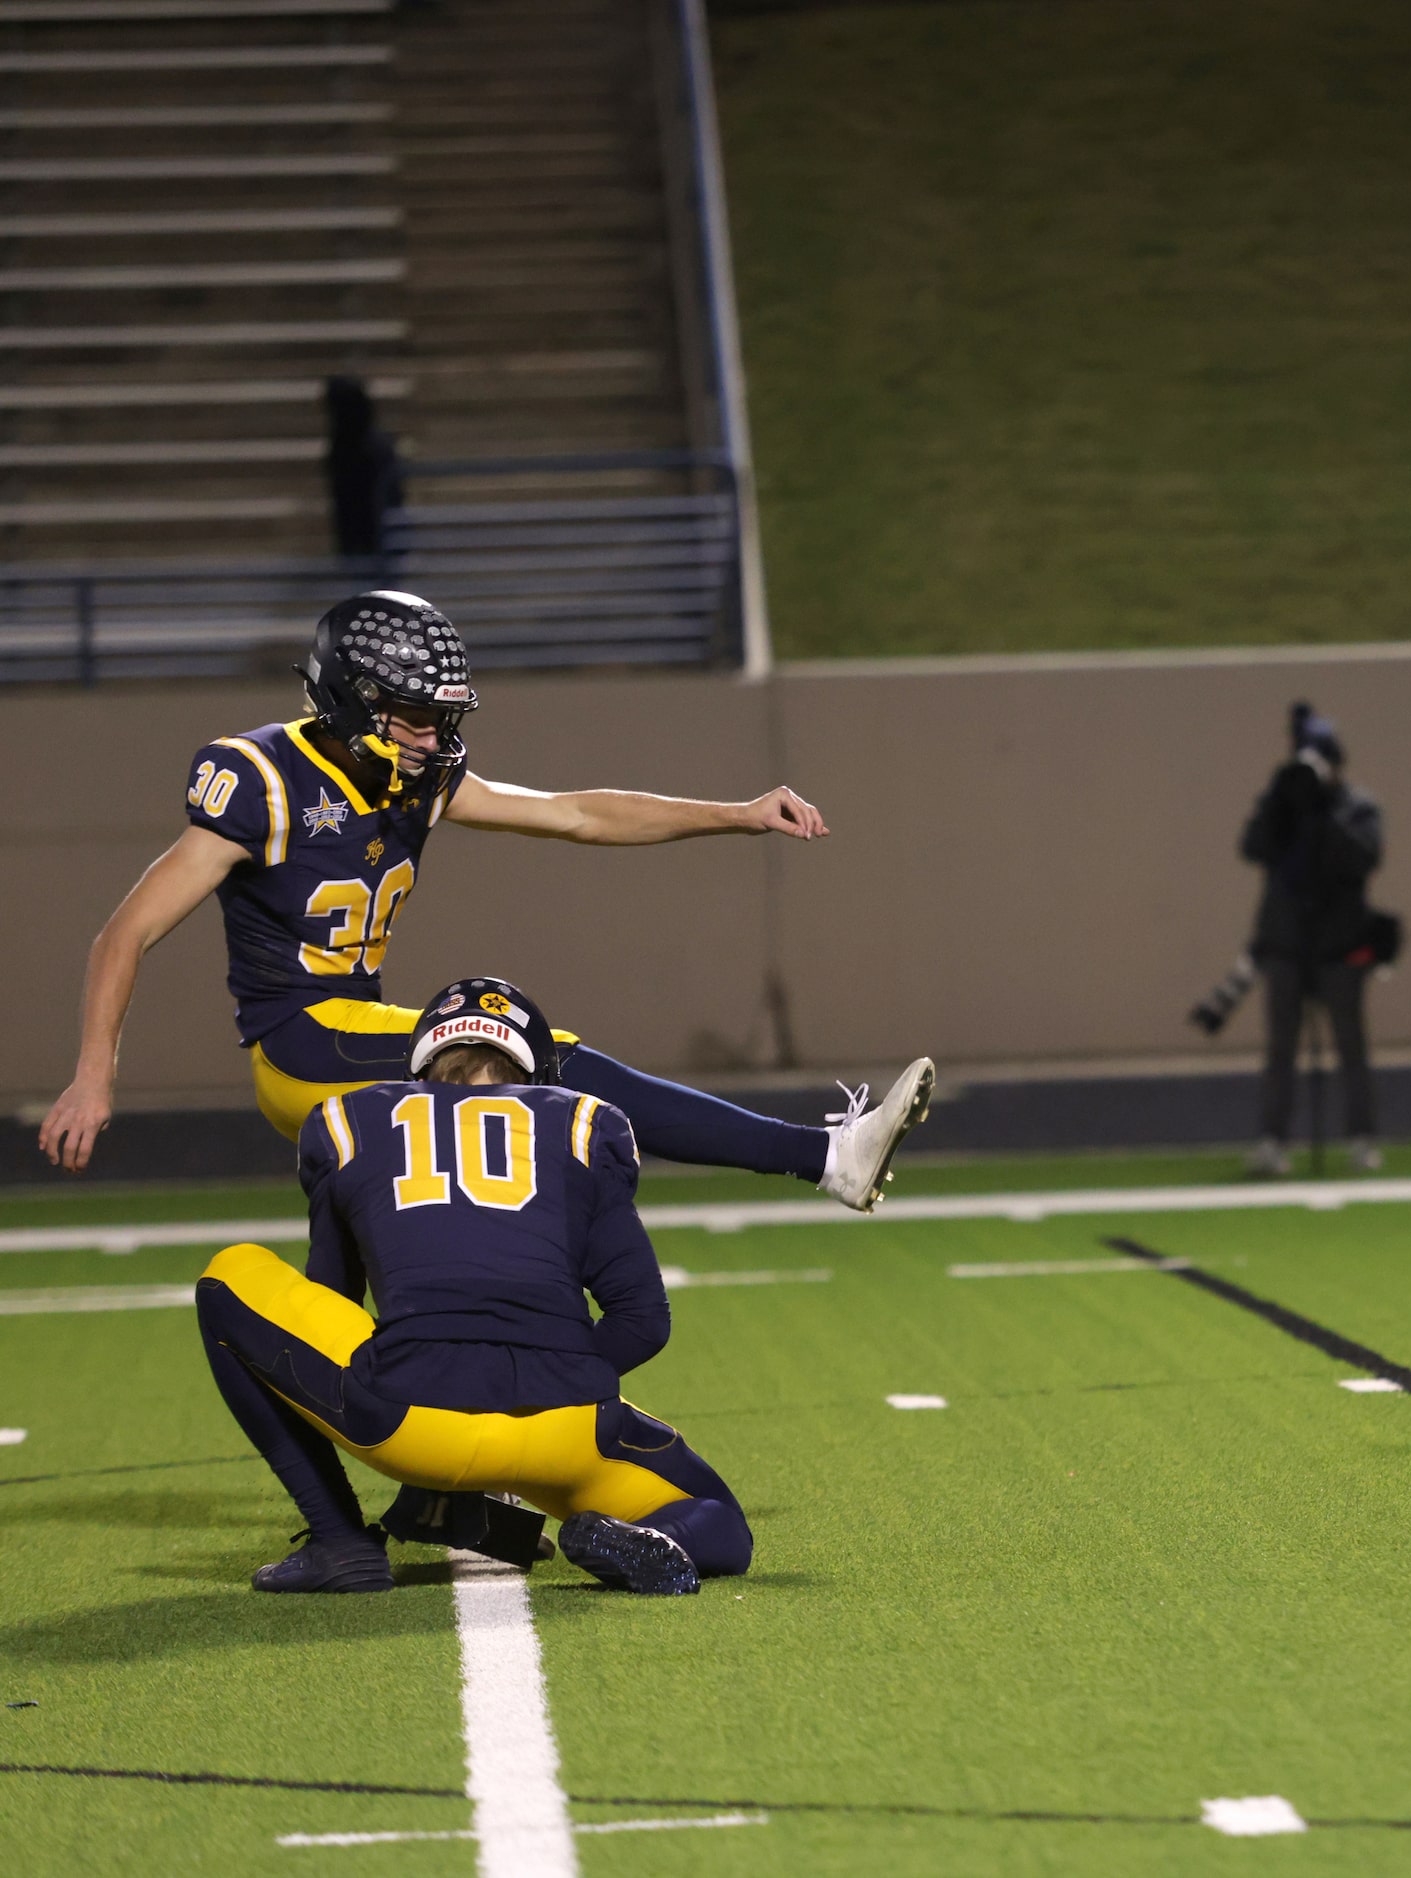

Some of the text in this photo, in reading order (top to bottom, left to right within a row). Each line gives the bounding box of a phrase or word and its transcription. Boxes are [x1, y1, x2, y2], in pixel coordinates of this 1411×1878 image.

[187, 760, 240, 818] 30
[298, 857, 415, 976] 30
[432, 1019, 510, 1043] Riddell
[391, 1093, 538, 1212] 10
